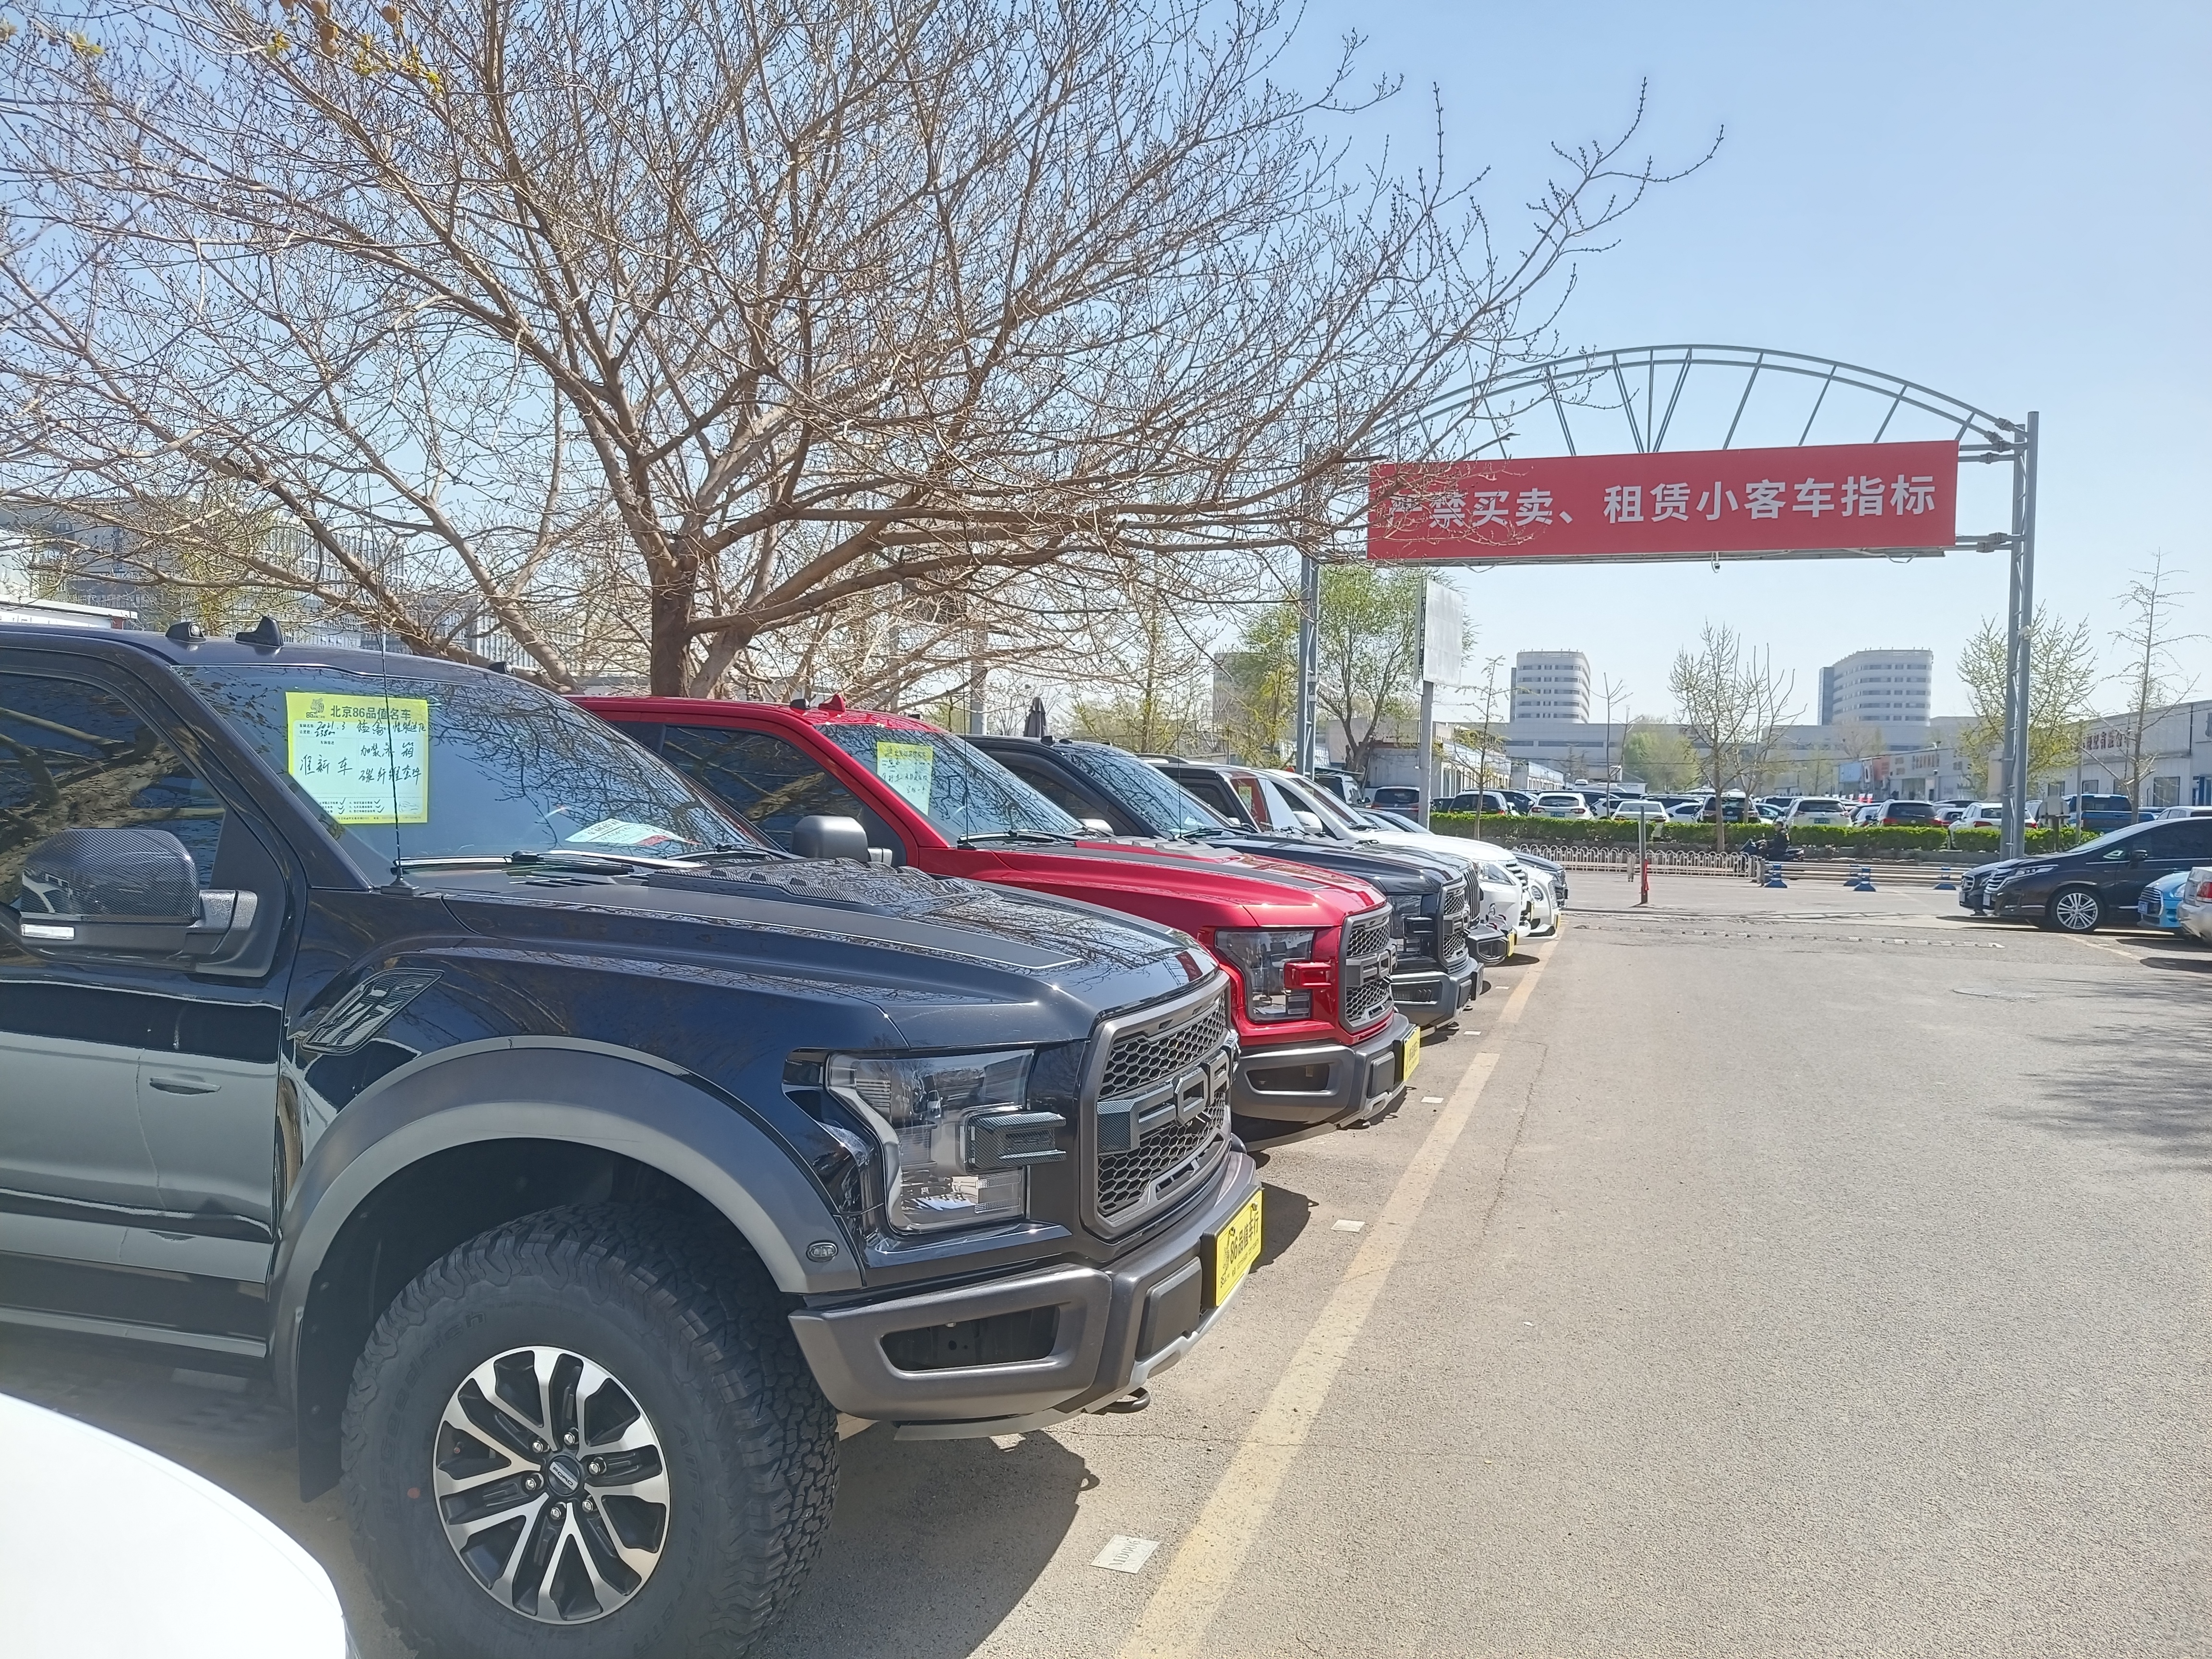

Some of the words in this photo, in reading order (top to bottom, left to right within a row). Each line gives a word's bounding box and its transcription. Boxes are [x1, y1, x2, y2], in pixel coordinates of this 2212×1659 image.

[331, 705, 411, 720] 北京86品值名车
[553, 1467, 573, 1486] FORD
